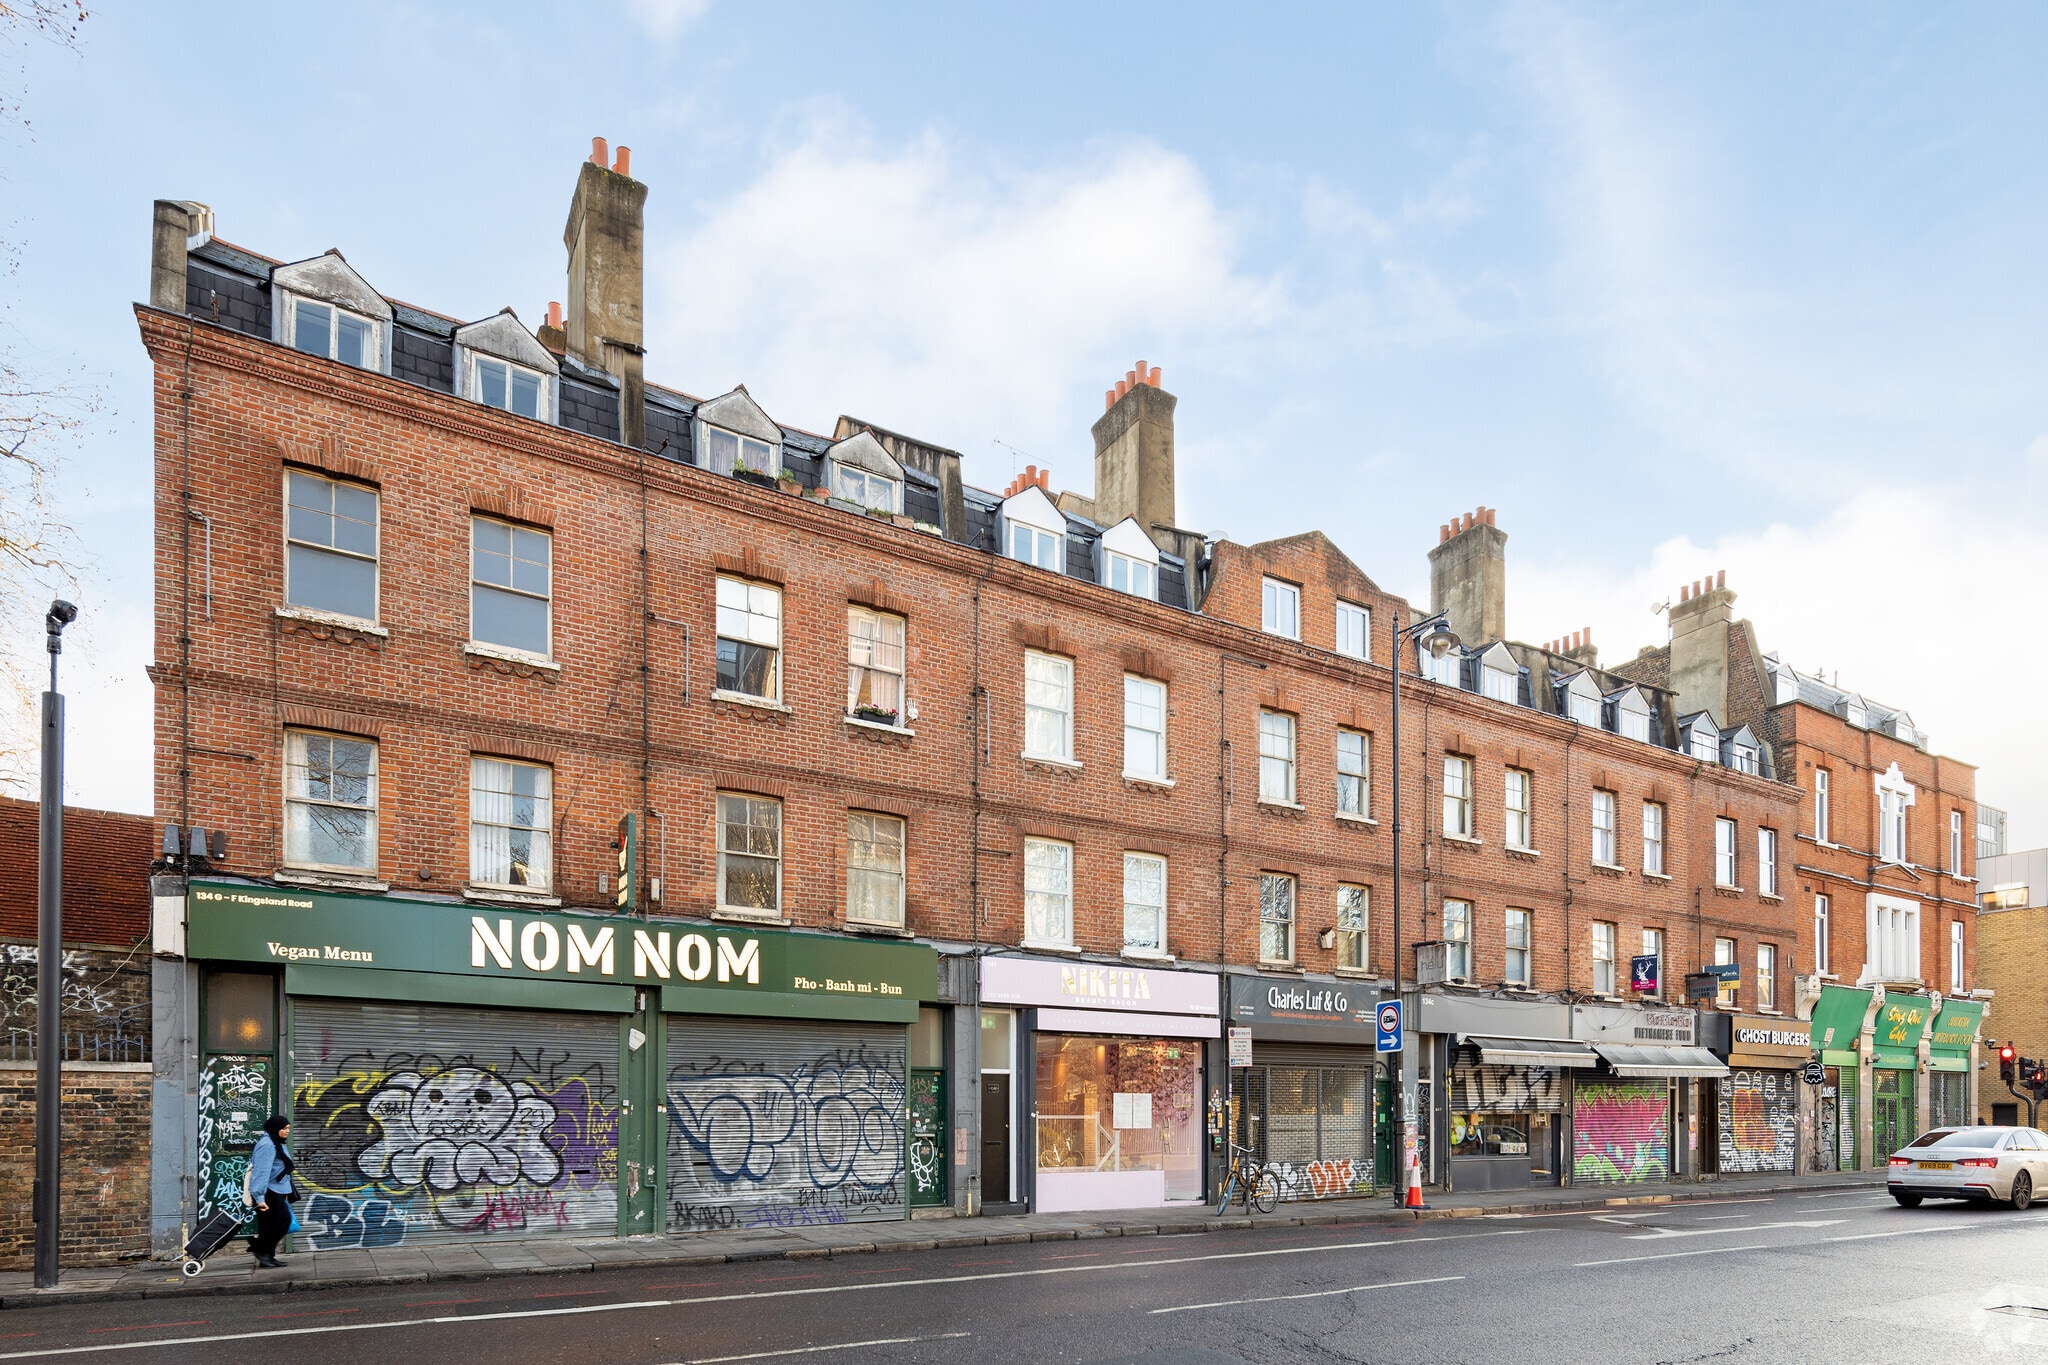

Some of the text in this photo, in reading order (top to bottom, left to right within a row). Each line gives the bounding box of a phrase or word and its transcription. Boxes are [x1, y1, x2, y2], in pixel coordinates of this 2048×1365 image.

[195, 891, 214, 901] 134
[238, 895, 287, 907] Kingsland
[288, 899, 313, 909] Road
[267, 941, 374, 963] Vegan Menu
[471, 916, 760, 985] NOM NOM
[793, 976, 817, 990] Pho
[825, 977, 856, 993] Banh
[857, 980, 872, 993] mi
[879, 982, 903, 995] Bun
[1060, 966, 1151, 1000] NIKITA
[1075, 996, 1137, 1006] BEAUTY SALON
[1268, 986, 1304, 1011] Charles
[1305, 989, 1323, 1011] Luf
[1323, 993, 1333, 1012] &
[1334, 991, 1347, 1012] Co
[1738, 1028, 1810, 1047] GHOST BURGERS
